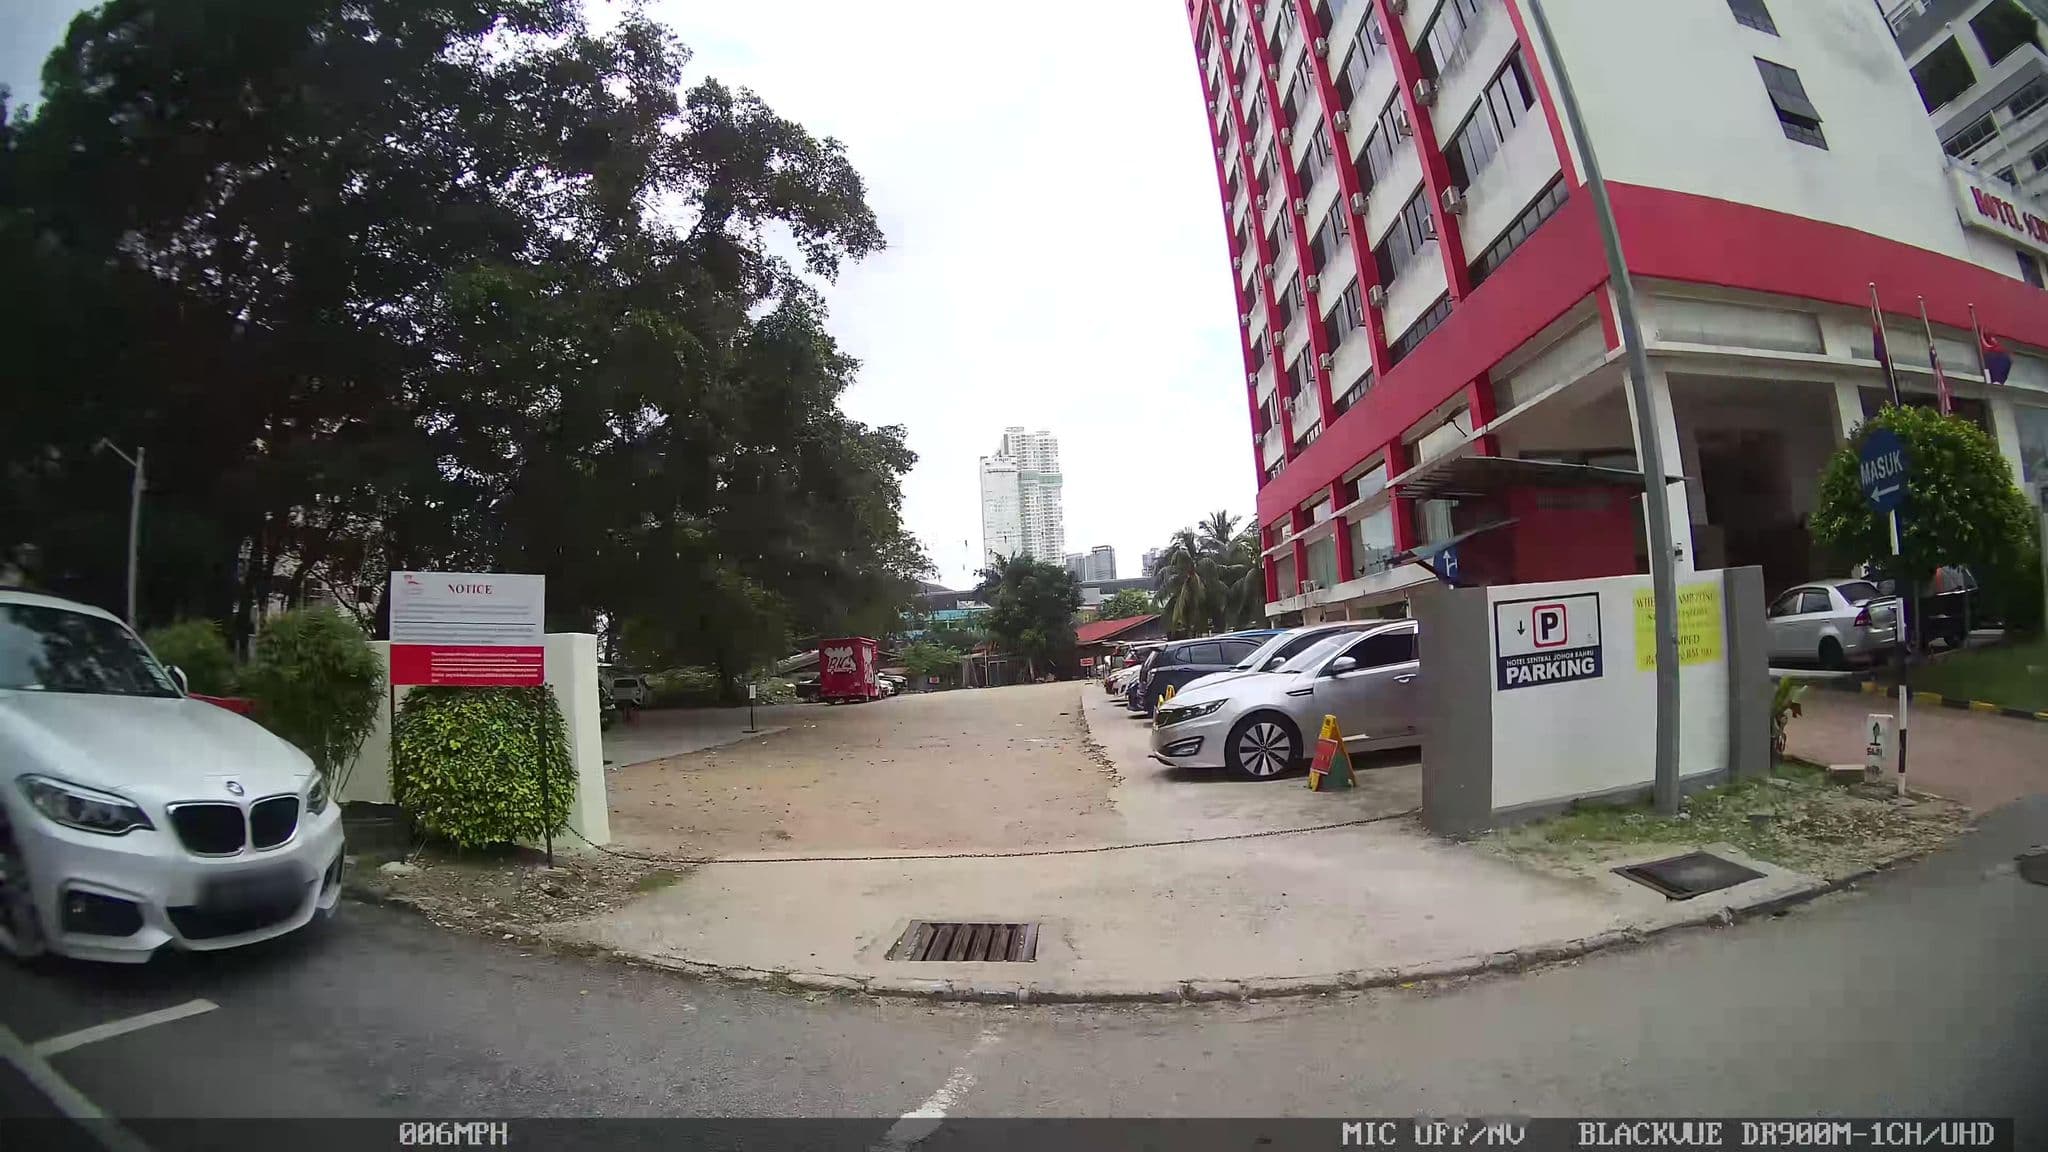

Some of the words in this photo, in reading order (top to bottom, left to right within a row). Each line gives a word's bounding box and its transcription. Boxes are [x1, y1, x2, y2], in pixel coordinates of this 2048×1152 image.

[1970, 186, 2024, 231] HOTEL
[1860, 450, 1903, 487] MASUK
[448, 583, 493, 595] NOTICE
[1541, 612, 1558, 640] P
[1506, 656, 1526, 666] HOTEL
[1527, 654, 1552, 664] SENTRAL
[1553, 651, 1574, 661] JOHOR
[1575, 649, 1594, 659] BAHRU
[1506, 657, 1595, 685] PARKING
